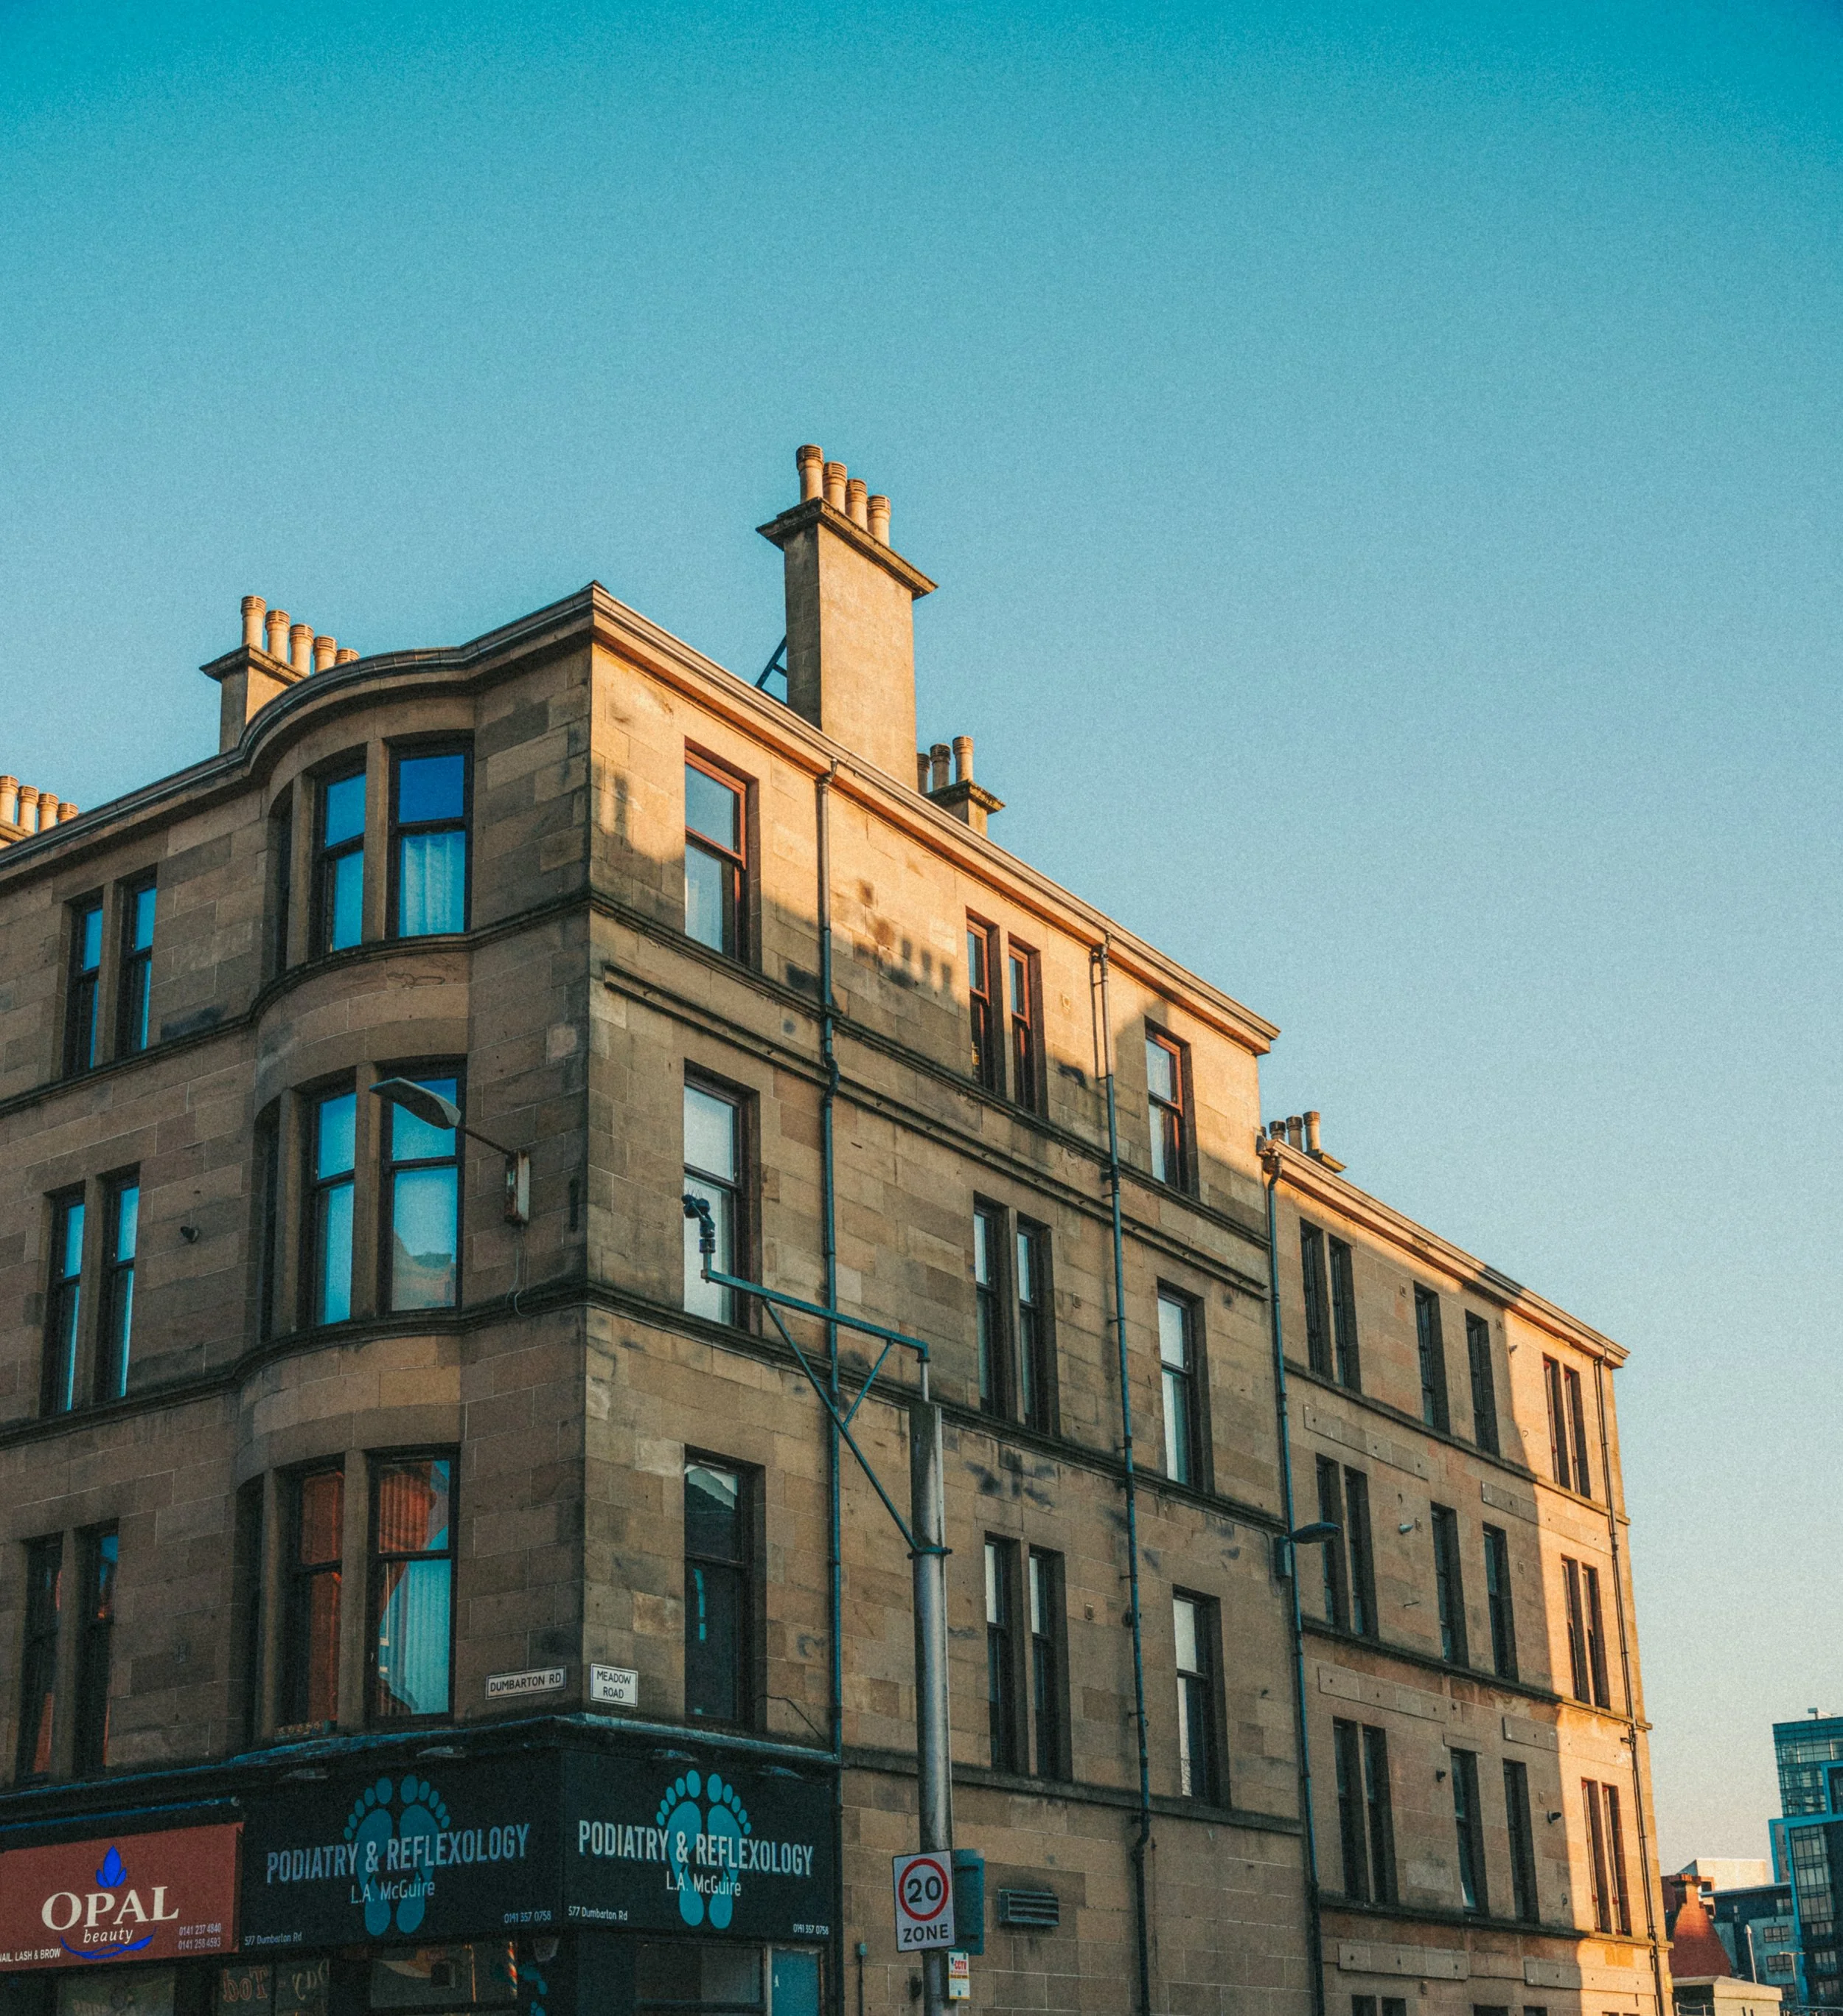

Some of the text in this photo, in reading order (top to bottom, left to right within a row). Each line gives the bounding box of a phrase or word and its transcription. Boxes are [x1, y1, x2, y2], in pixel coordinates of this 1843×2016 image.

[490, 1672, 561, 1692] DUMBARTON RD
[596, 1670, 631, 1685] MEADOW
[602, 1686, 624, 1699] ROAD
[267, 1823, 530, 1883] PODIATRY & REFLEXOLOGY
[579, 1820, 813, 1875] PODIATRY & REFLEXOLOGY
[350, 1878, 435, 1904] L.A. McGuire
[666, 1871, 741, 1897] L.A. McGuire
[907, 1876, 941, 1903] 20
[41, 1886, 179, 1930] OPAL
[568, 1906, 627, 1921] 577 Dumbarton Rd
[504, 1911, 551, 1924] 0141 357 0758
[83, 1929, 133, 1944] beauty
[179, 1926, 193, 1936] 0141
[195, 1925, 206, 1935] 237
[793, 1924, 829, 1935] 0141 357 0758
[903, 1924, 949, 1943] ZONE
[178, 1940, 192, 1950] 0141
[245, 1932, 302, 1945] 577 Dumbarton Rd
[15, 1950, 32, 1962] LASH
[33, 1950, 38, 1960] &
[40, 1947, 61, 1959] BROW
